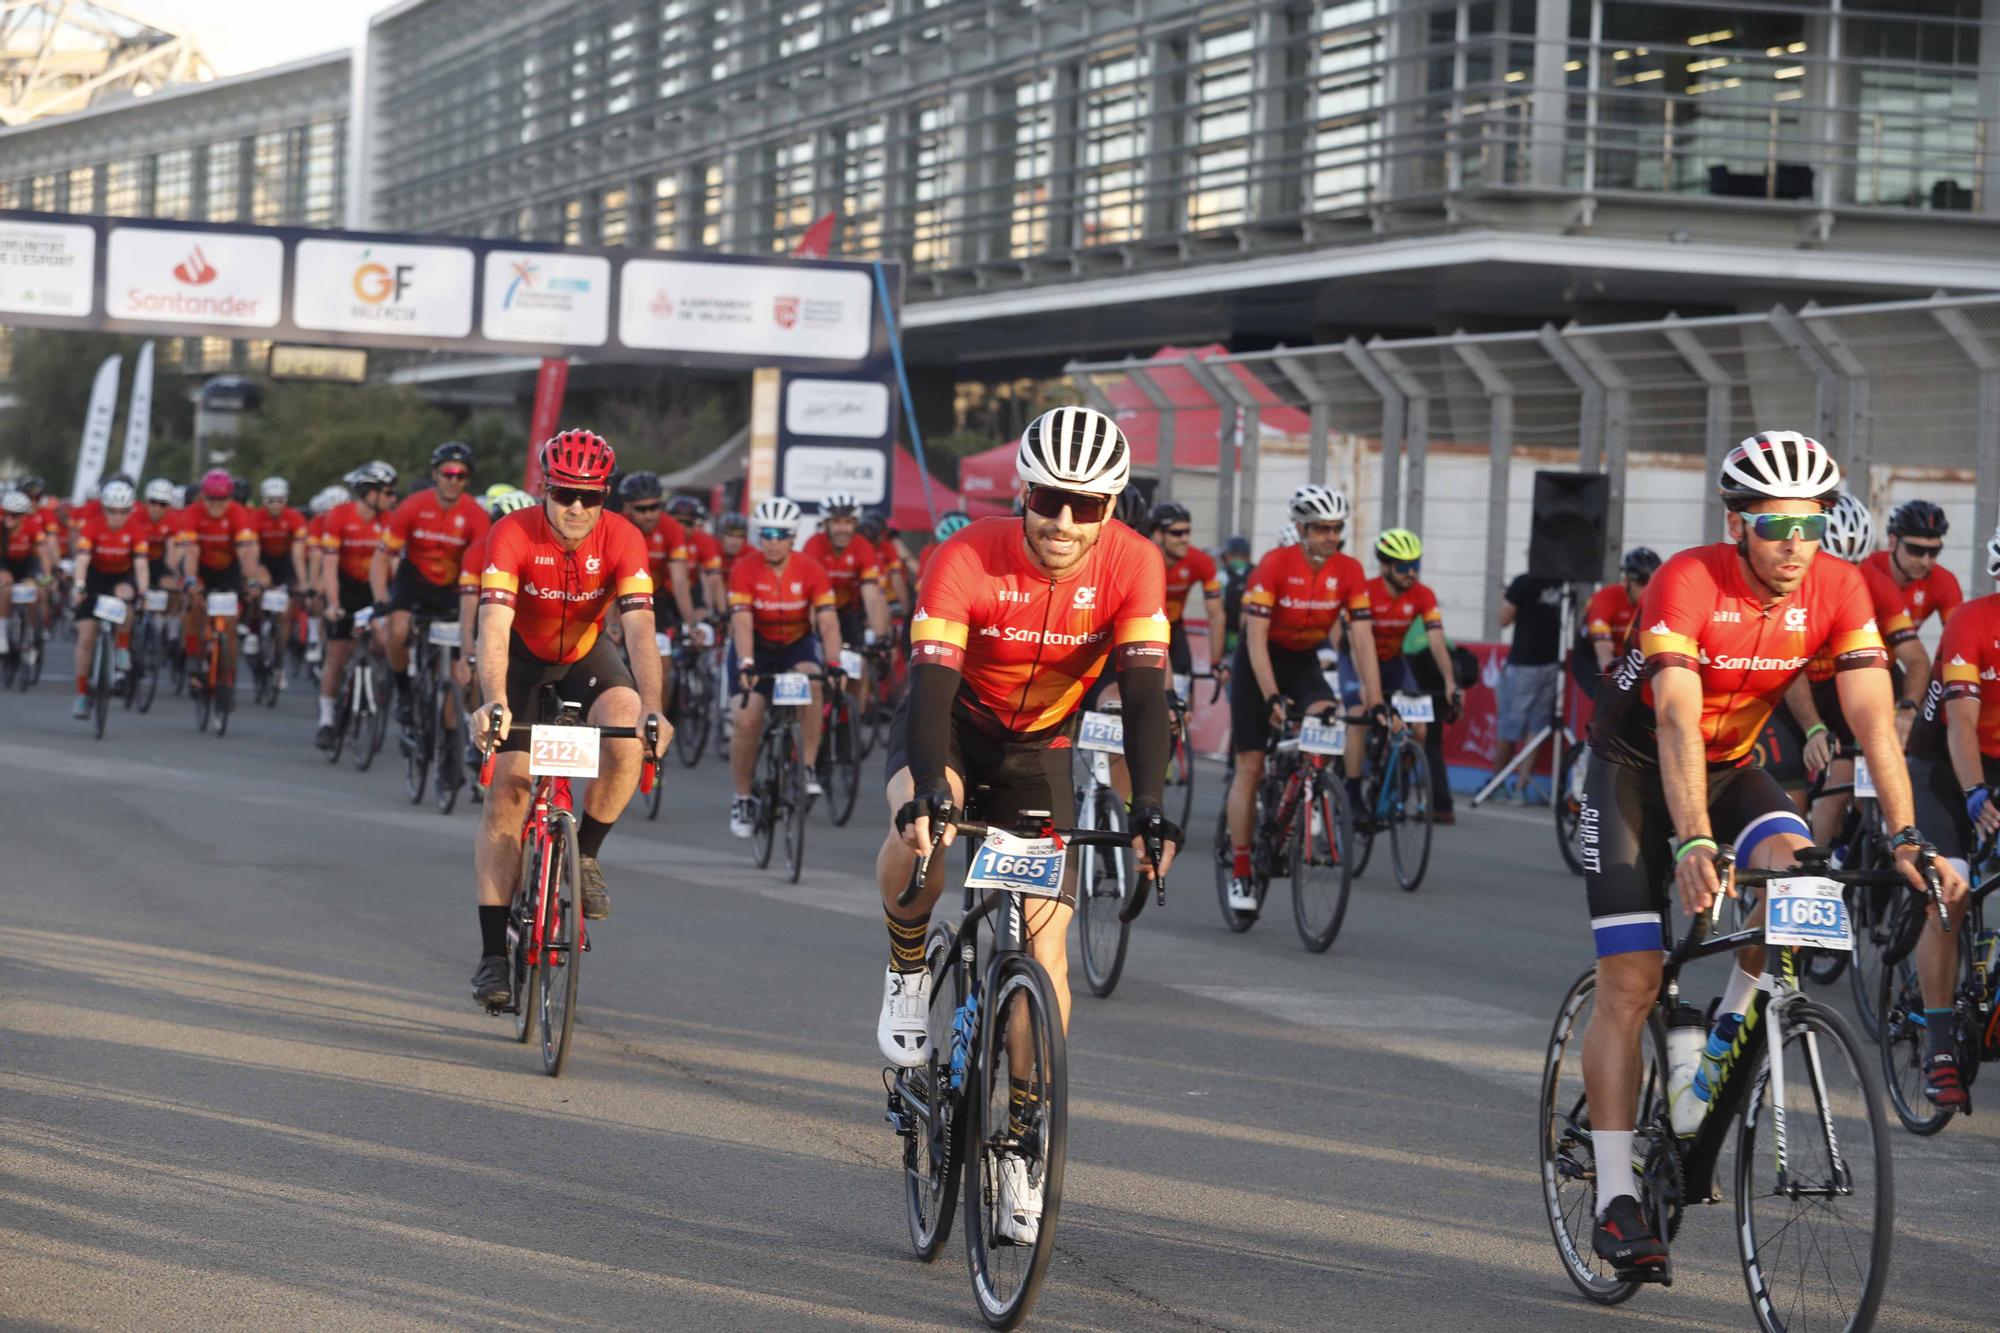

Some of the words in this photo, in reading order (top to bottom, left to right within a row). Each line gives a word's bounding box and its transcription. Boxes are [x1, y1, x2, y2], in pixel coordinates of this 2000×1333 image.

[127, 286, 261, 318] Santander
[539, 585, 606, 603] Santande
[1002, 625, 1108, 647] Santander
[1710, 653, 1809, 672] Santande
[1087, 722, 1123, 742] 1216
[535, 740, 583, 761] 2127
[982, 851, 1047, 879] 1665
[1775, 898, 1837, 928] 1663
